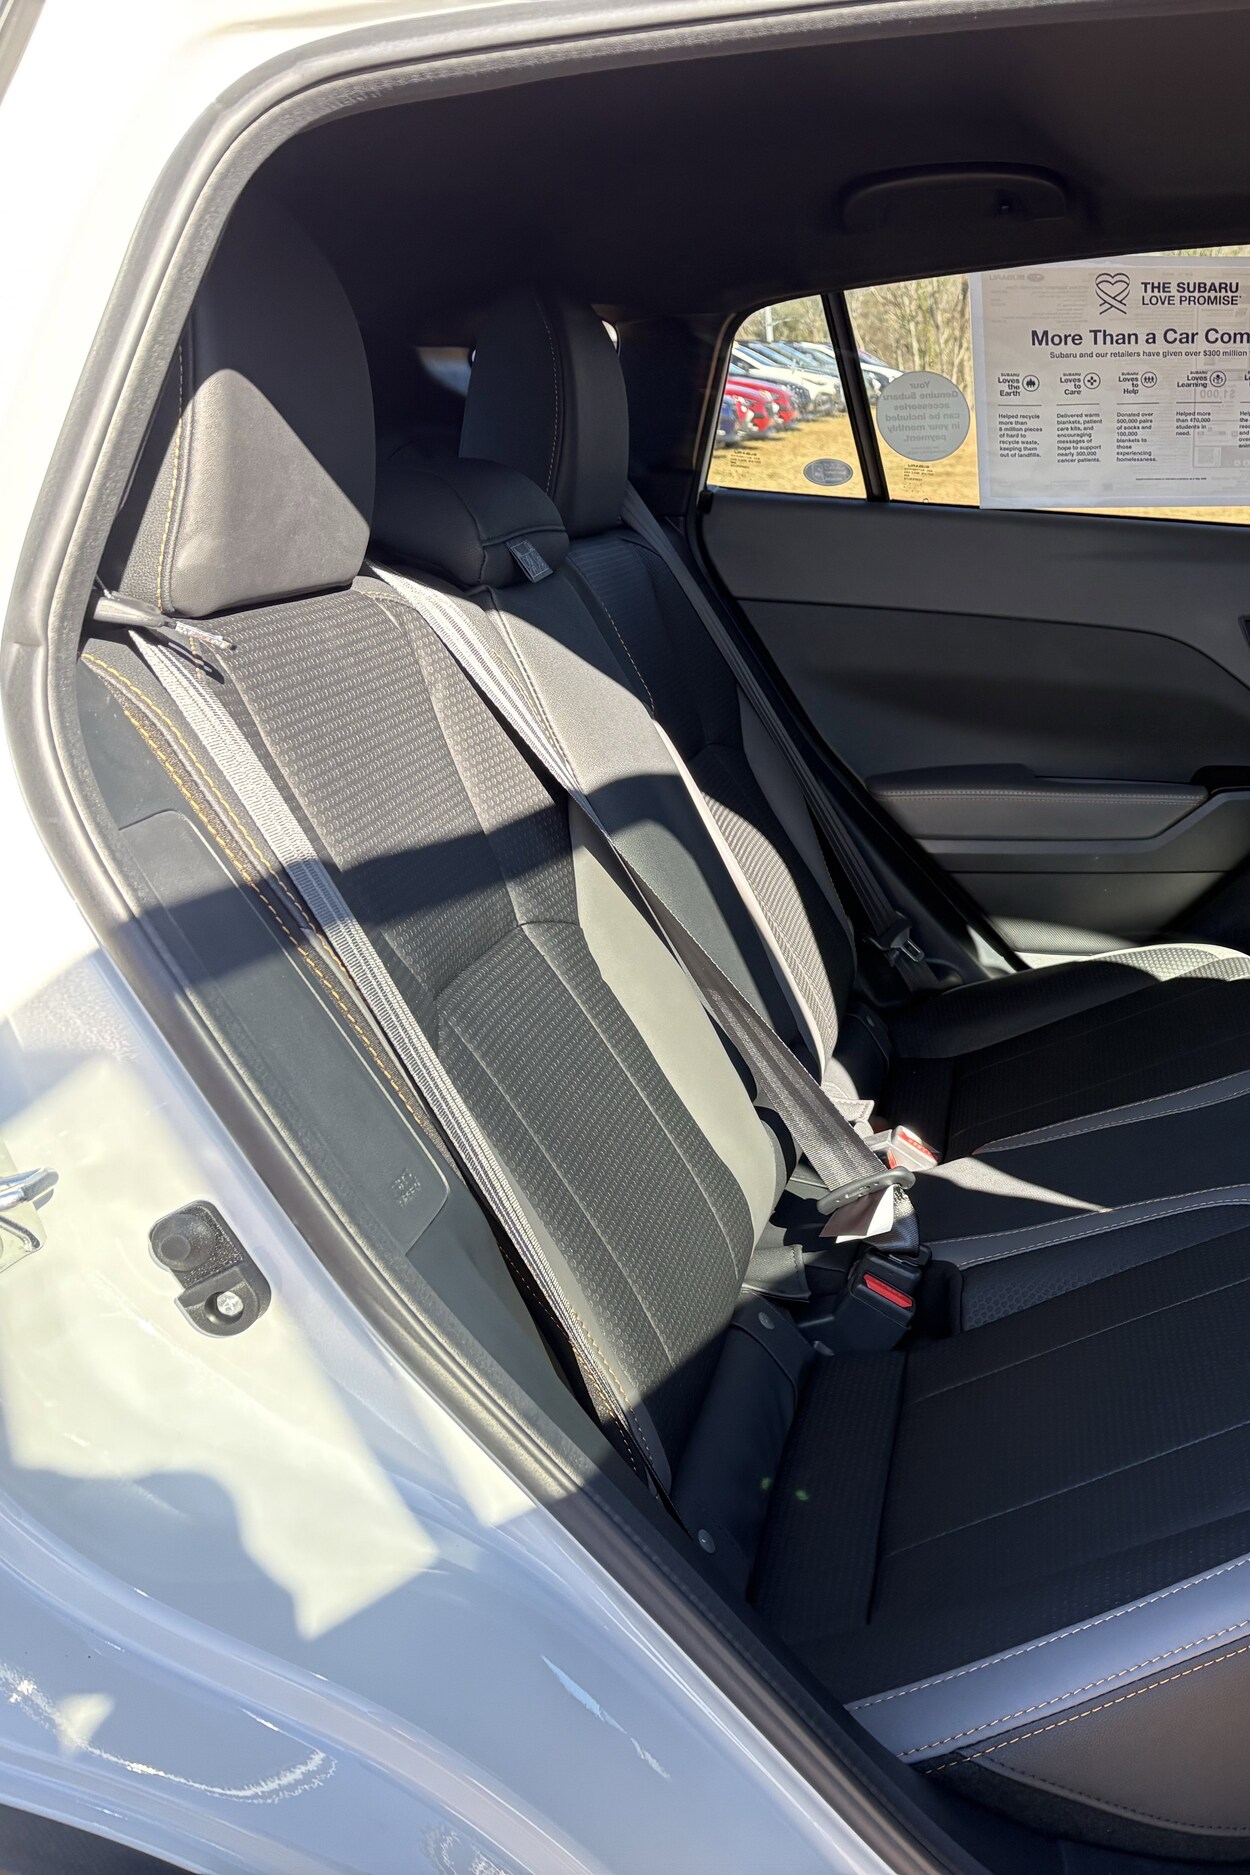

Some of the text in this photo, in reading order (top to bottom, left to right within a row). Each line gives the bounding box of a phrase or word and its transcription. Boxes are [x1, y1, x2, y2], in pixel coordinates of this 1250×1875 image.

[1140, 282, 1239, 294] THE SUBARU
[1141, 295, 1241, 306] LOVE PROMISE
[1031, 330, 1083, 346] More
[1089, 329, 1139, 346] Than
[1145, 332, 1157, 345] a
[1163, 328, 1198, 344] Car
[1049, 351, 1077, 359] Subaru
[1162, 350, 1183, 358] given
